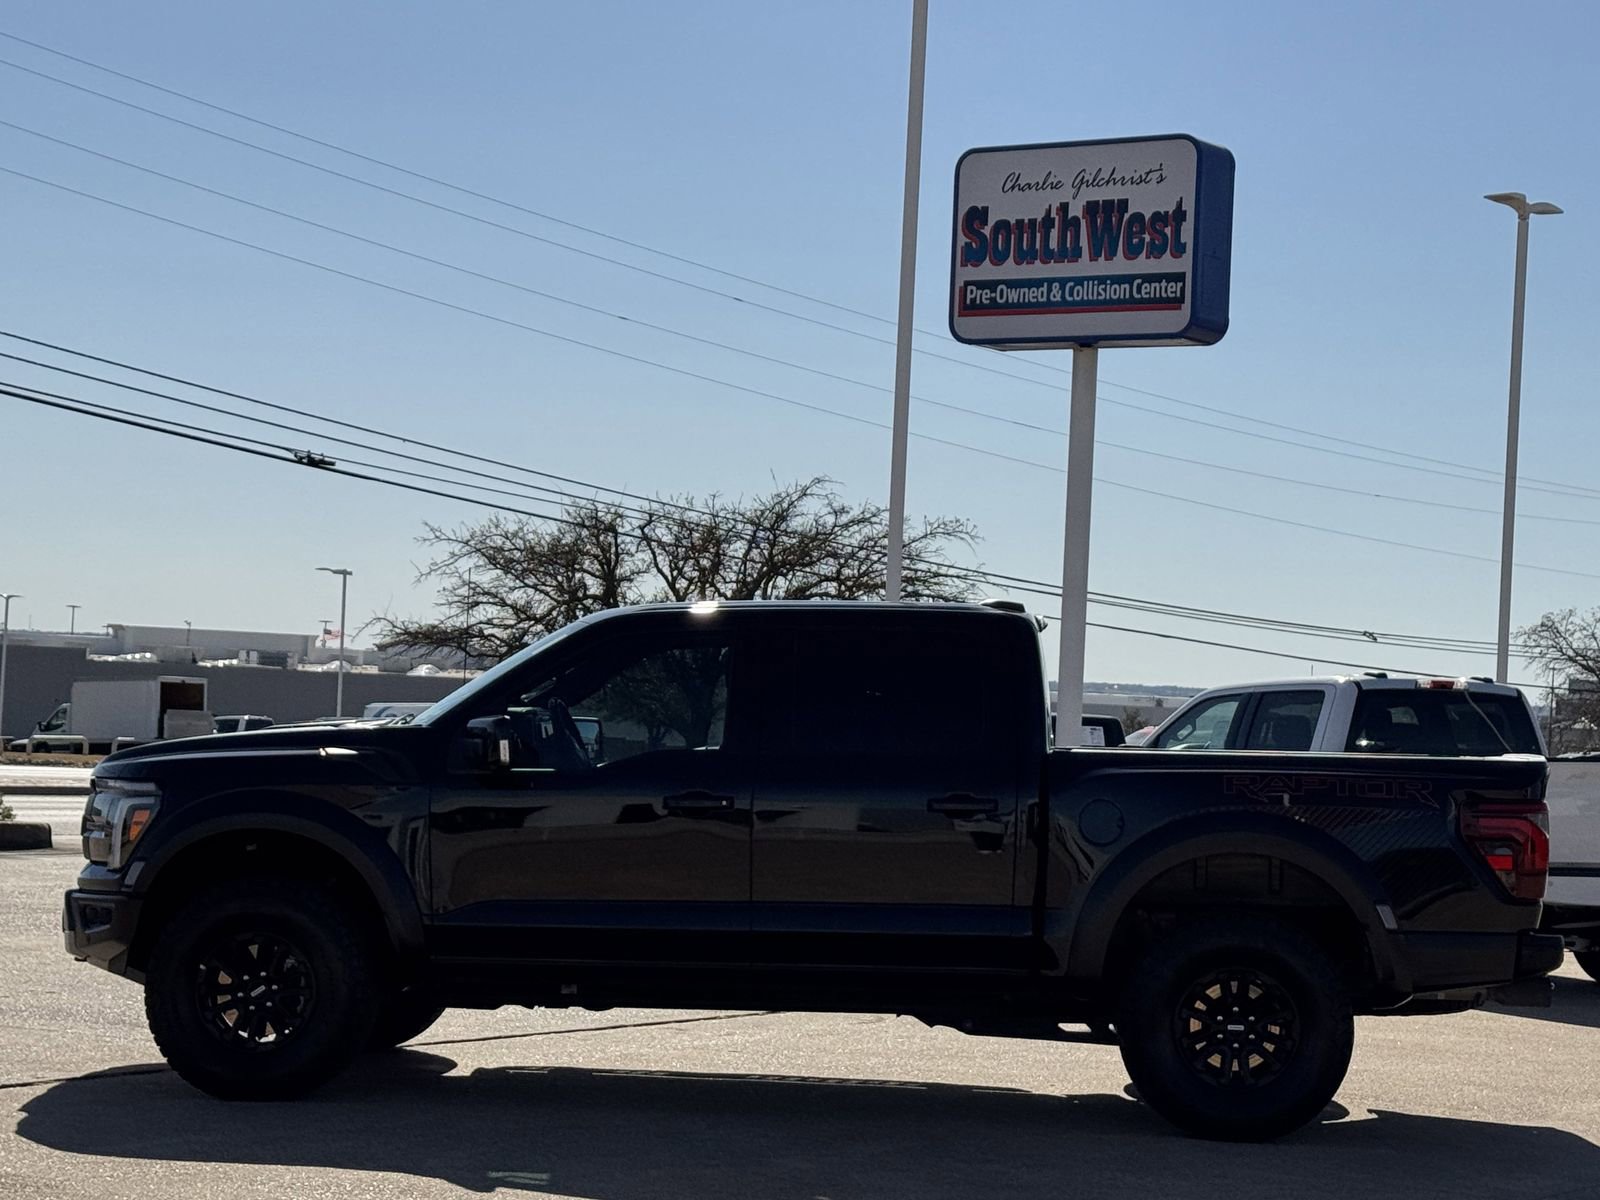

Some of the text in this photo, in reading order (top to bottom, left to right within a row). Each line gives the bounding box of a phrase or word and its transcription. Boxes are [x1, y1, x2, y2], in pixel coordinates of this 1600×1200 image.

[1001, 163, 1167, 200] Charlie Gilchrist's
[966, 276, 1184, 305] Pre-Owned & Collision Center
[1223, 775, 1440, 808] RAPTOR
